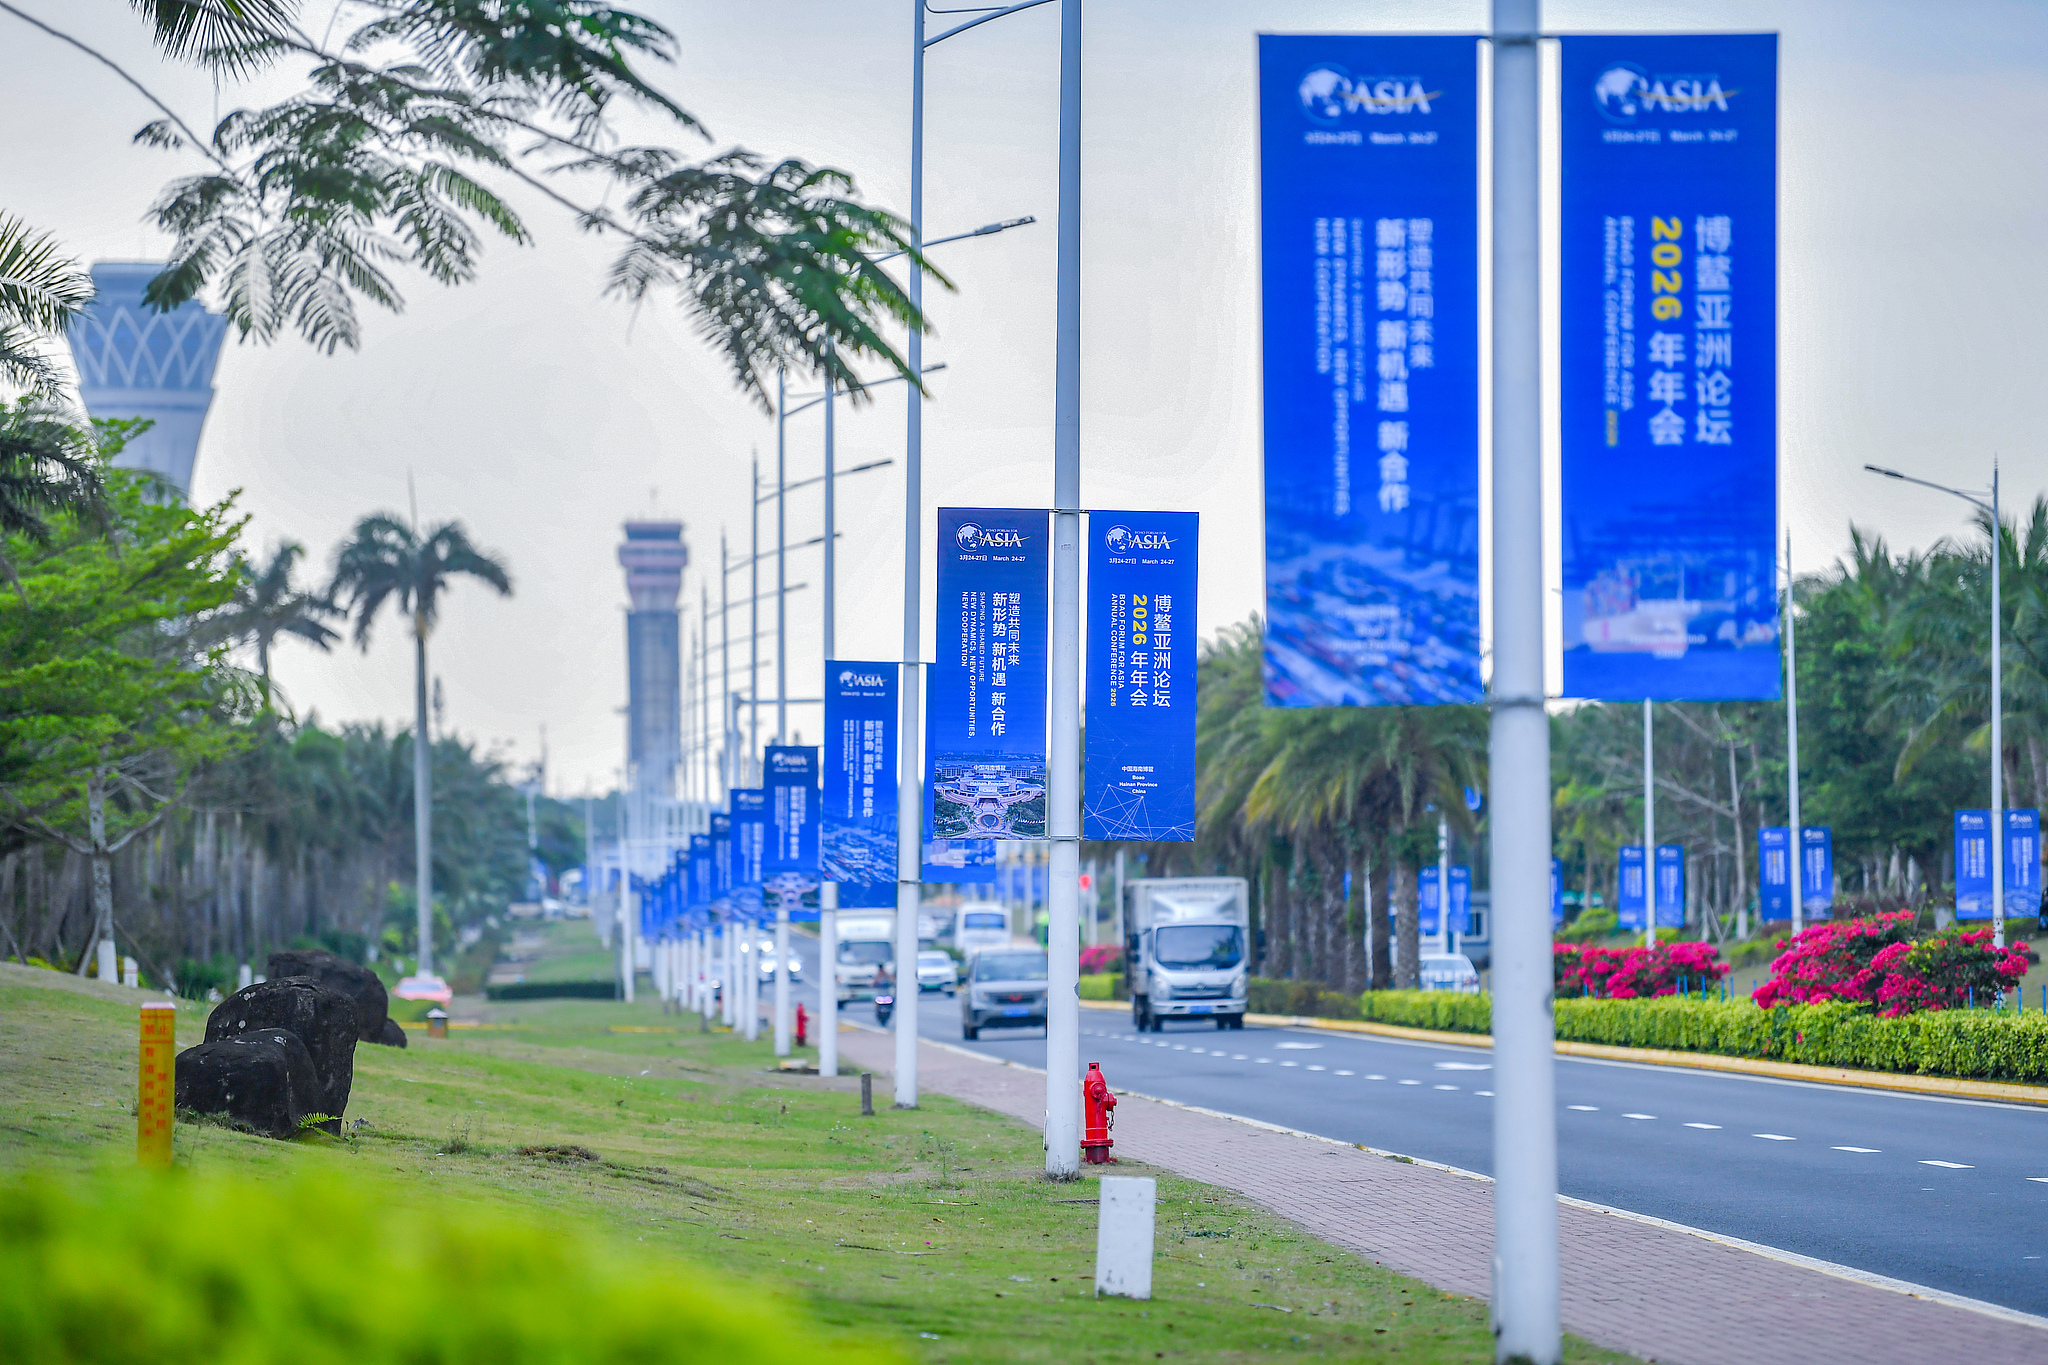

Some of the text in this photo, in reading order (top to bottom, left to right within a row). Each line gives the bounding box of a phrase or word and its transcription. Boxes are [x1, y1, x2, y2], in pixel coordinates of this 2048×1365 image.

[1345, 80, 1432, 114] ASIA
[1642, 80, 1729, 112] ASIA
[1648, 215, 1687, 446] 2026 年年会
[981, 532, 1022, 548] ASIA
[1130, 534, 1171, 550] ASIA
[959, 554, 988, 562] 3月24-27日
[1108, 557, 1137, 565] 3月24-27日
[1110, 593, 1118, 628] ANNUAL
[1118, 593, 1126, 618] BOAO
[961, 591, 969, 667] NEW COOPERATION
[969, 611, 977, 654] DYNAMICS,
[1008, 592, 1021, 667] 塑造共同未来
[1118, 619, 1126, 649] FORUM
[990, 592, 1007, 737] 新形势 新机遇 新合作
[1129, 593, 1149, 707] 2026 年年会
[1152, 594, 1172, 708] 博鳌亚洲论坛
[855, 676, 883, 687] ASIA
[1117, 669, 1125, 689] ASIA
[967, 674, 976, 739] OPPORTUNITIES,
